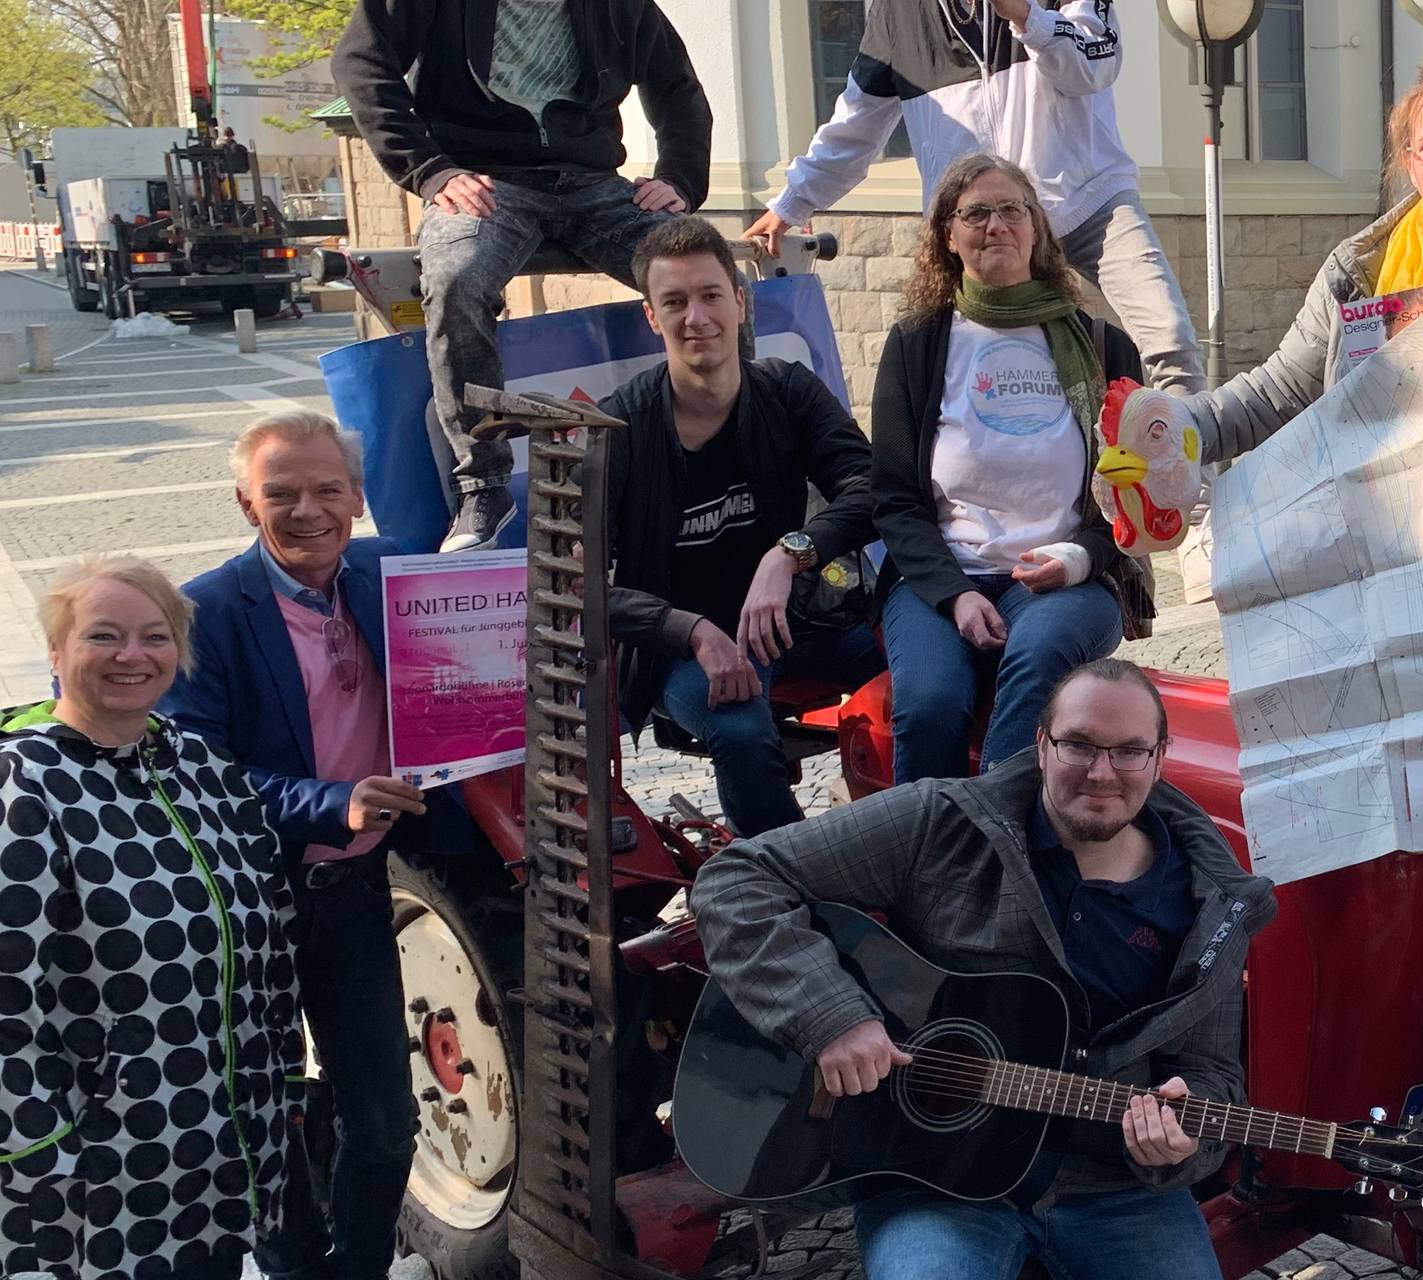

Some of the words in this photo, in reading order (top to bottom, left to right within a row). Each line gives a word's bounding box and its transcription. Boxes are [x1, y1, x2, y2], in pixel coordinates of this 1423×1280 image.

[996, 369, 1059, 382] HAMMER
[998, 382, 1061, 396] FORUM
[395, 594, 488, 617] UNITED
[496, 591, 527, 609] HA
[408, 624, 459, 638] FESTIVAL
[460, 623, 477, 634] für
[498, 639, 508, 649] 1.
